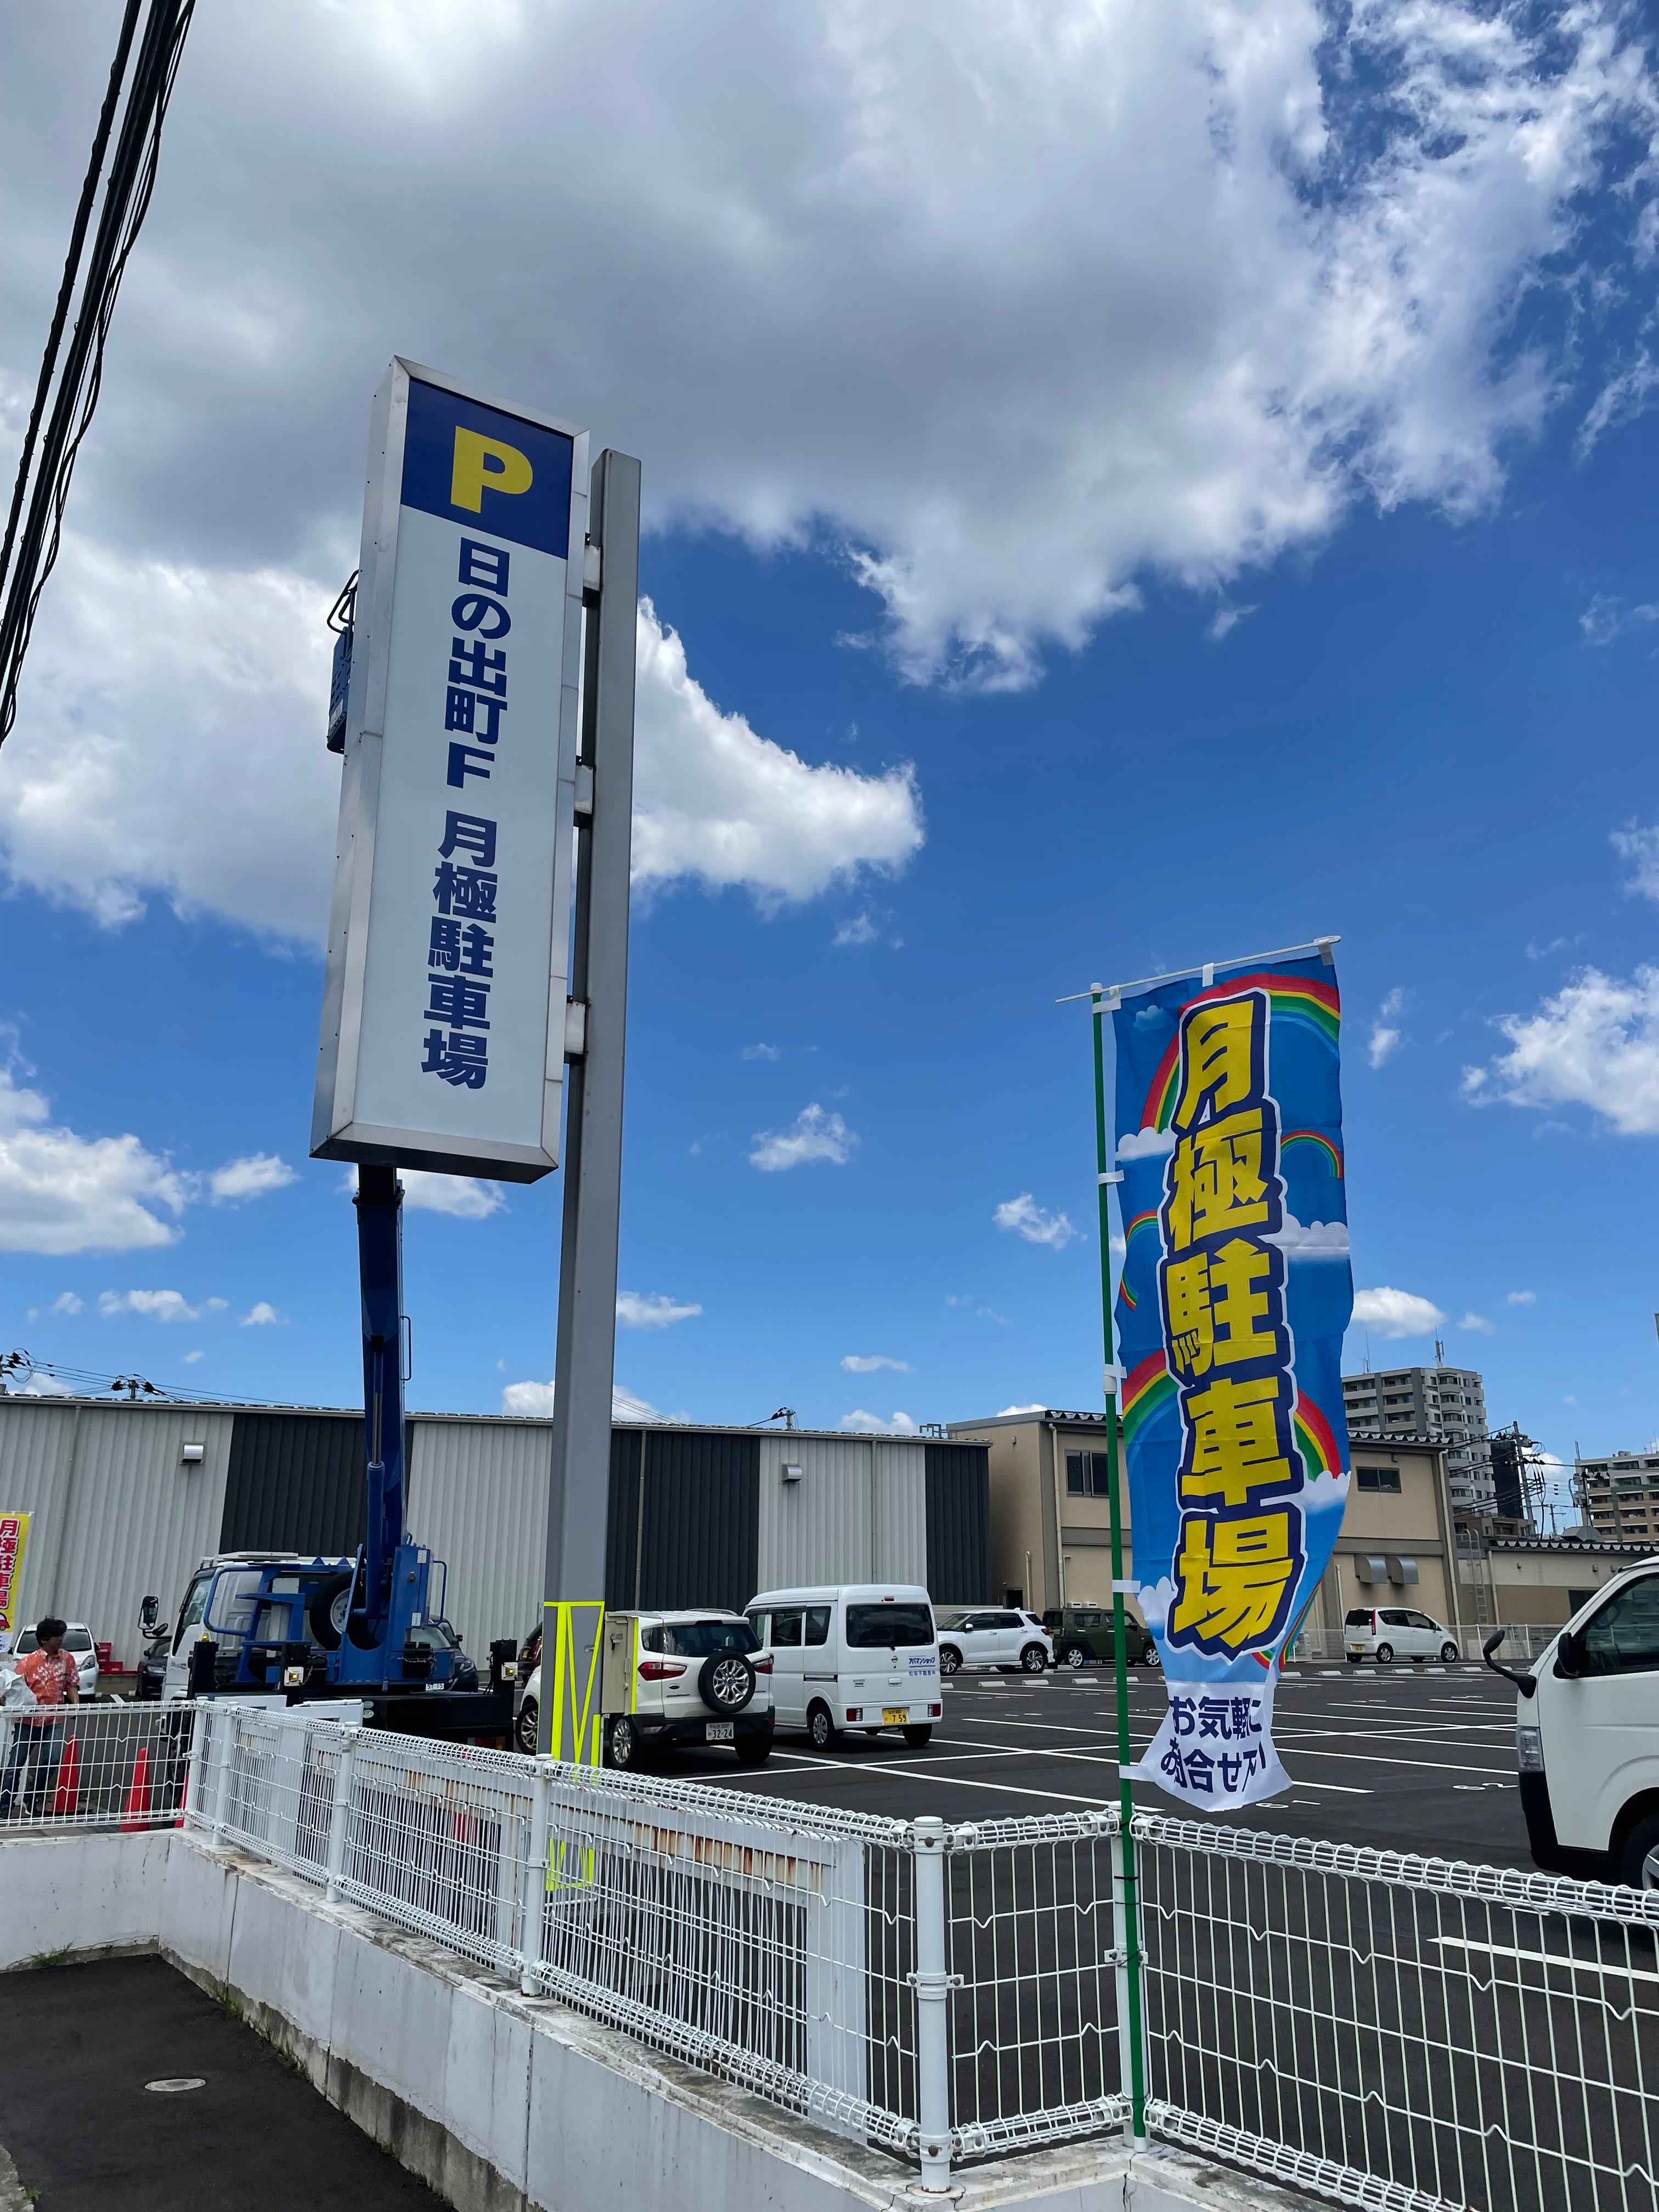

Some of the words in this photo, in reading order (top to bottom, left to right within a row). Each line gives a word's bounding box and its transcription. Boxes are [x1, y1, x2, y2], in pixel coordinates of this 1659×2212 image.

[450, 425, 533, 514] P
[444, 537, 511, 789] 日の出町F
[421, 809, 498, 1090] 月極駐車場
[1166, 998, 1294, 1648] 月極駐車場
[713, 1729, 732, 1739] 32-24
[1170, 1696, 1262, 1740] お気軽に
